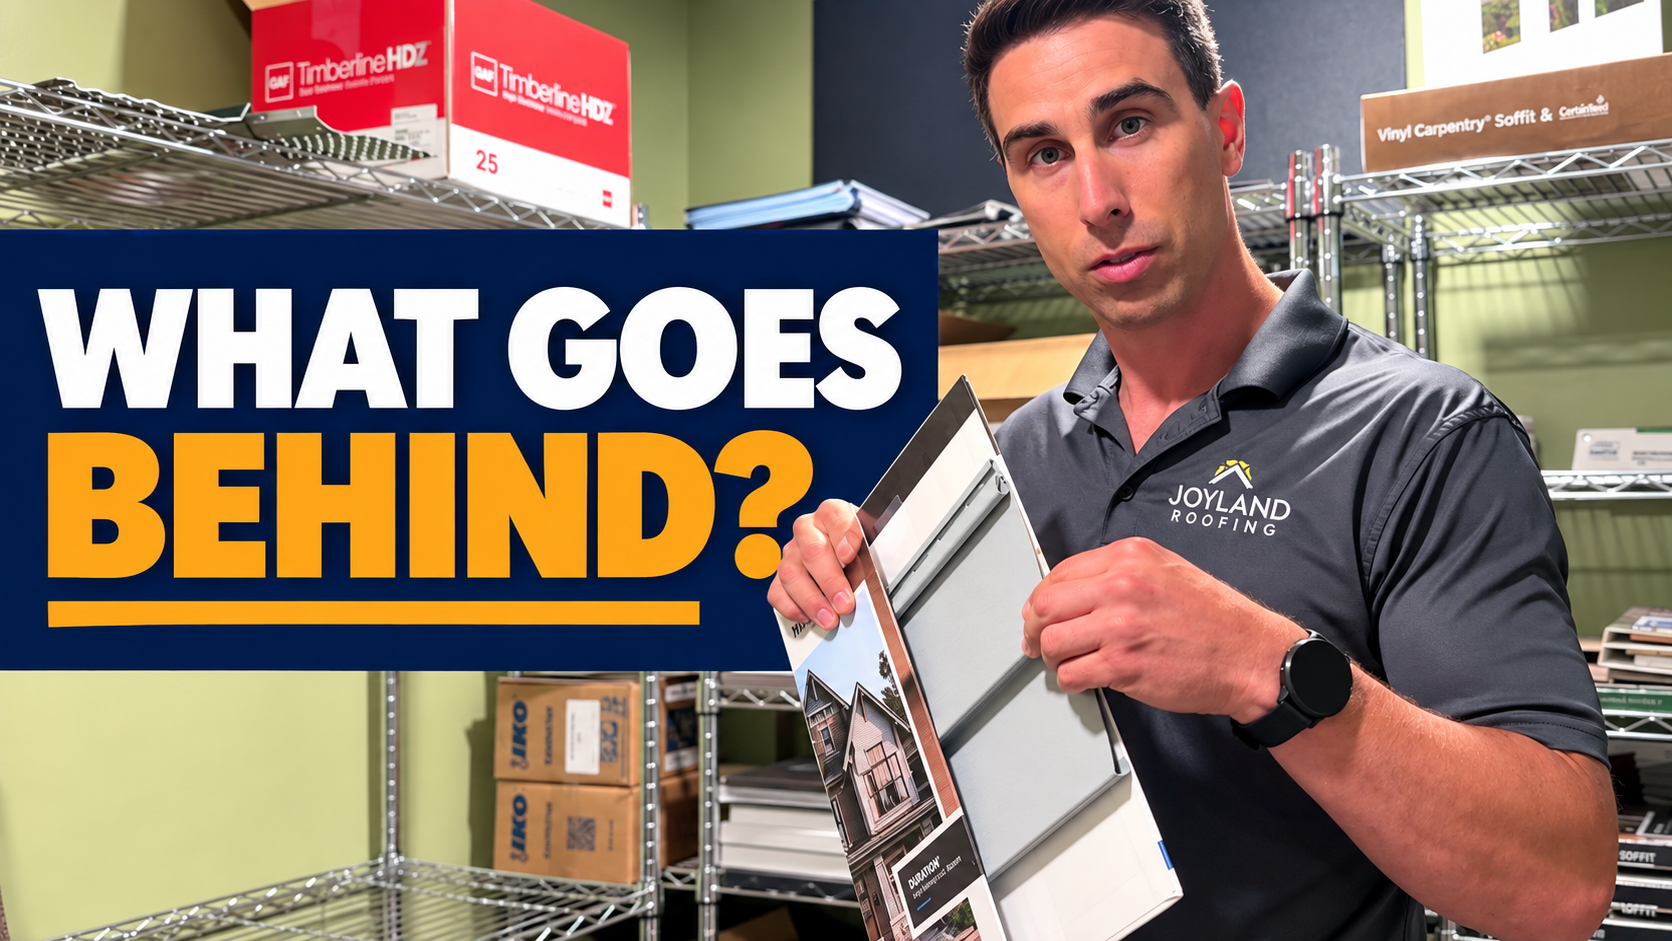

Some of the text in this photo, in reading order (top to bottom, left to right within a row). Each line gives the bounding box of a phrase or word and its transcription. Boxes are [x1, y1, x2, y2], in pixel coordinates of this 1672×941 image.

[1377, 124, 1412, 143] Vinyl
[1494, 109, 1537, 128] Soffit
[1539, 107, 1553, 123] &
[476, 149, 499, 174] 25
[1168, 484, 1291, 521] JOYLAND
[1170, 509, 1276, 537] ROOFING
[512, 701, 528, 759] IKO
[511, 794, 528, 852] IKO
[1618, 850, 1656, 863] SOFFIT
